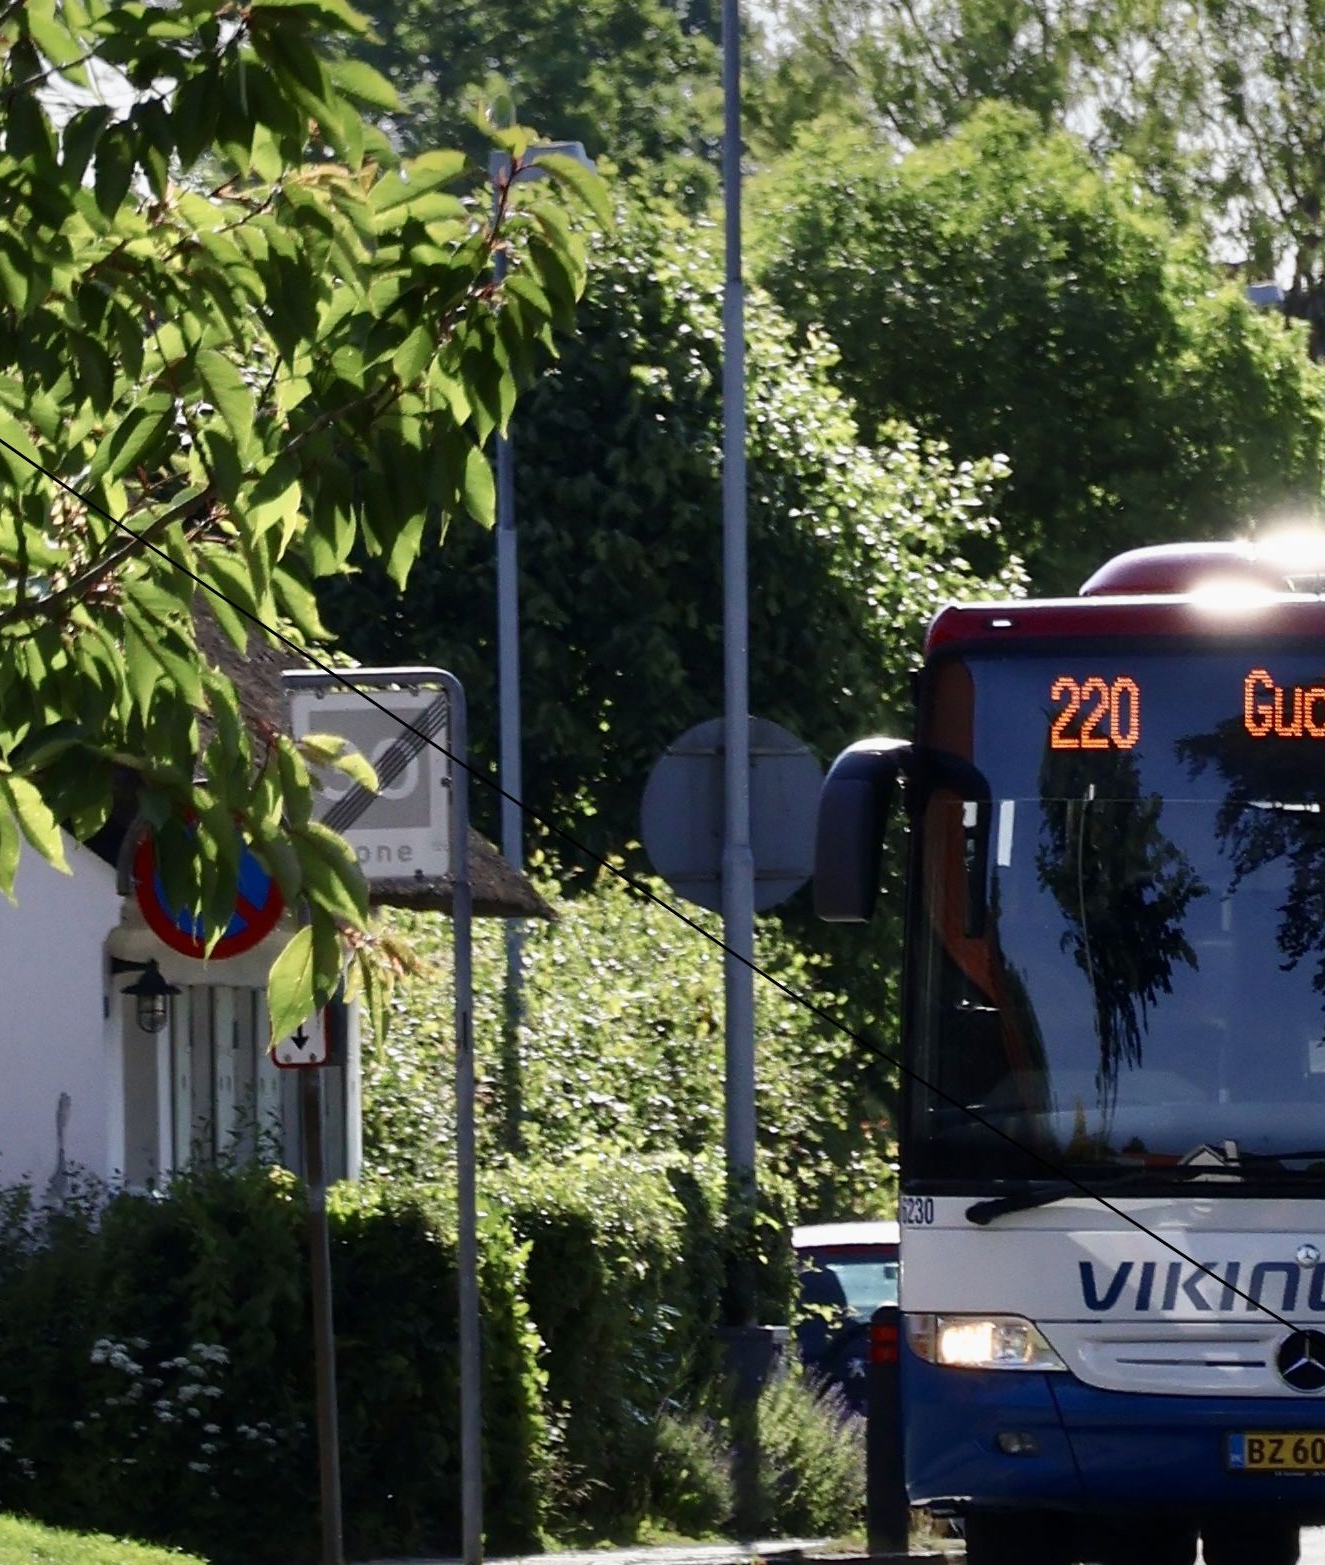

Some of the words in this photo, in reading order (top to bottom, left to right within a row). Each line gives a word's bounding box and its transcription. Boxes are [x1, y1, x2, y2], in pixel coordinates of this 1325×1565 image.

[1051, 676, 1140, 749] 220
[358, 844, 413, 863] one
[1247, 1438, 1284, 1465] BZ
[1292, 1437, 1325, 1465] 60
